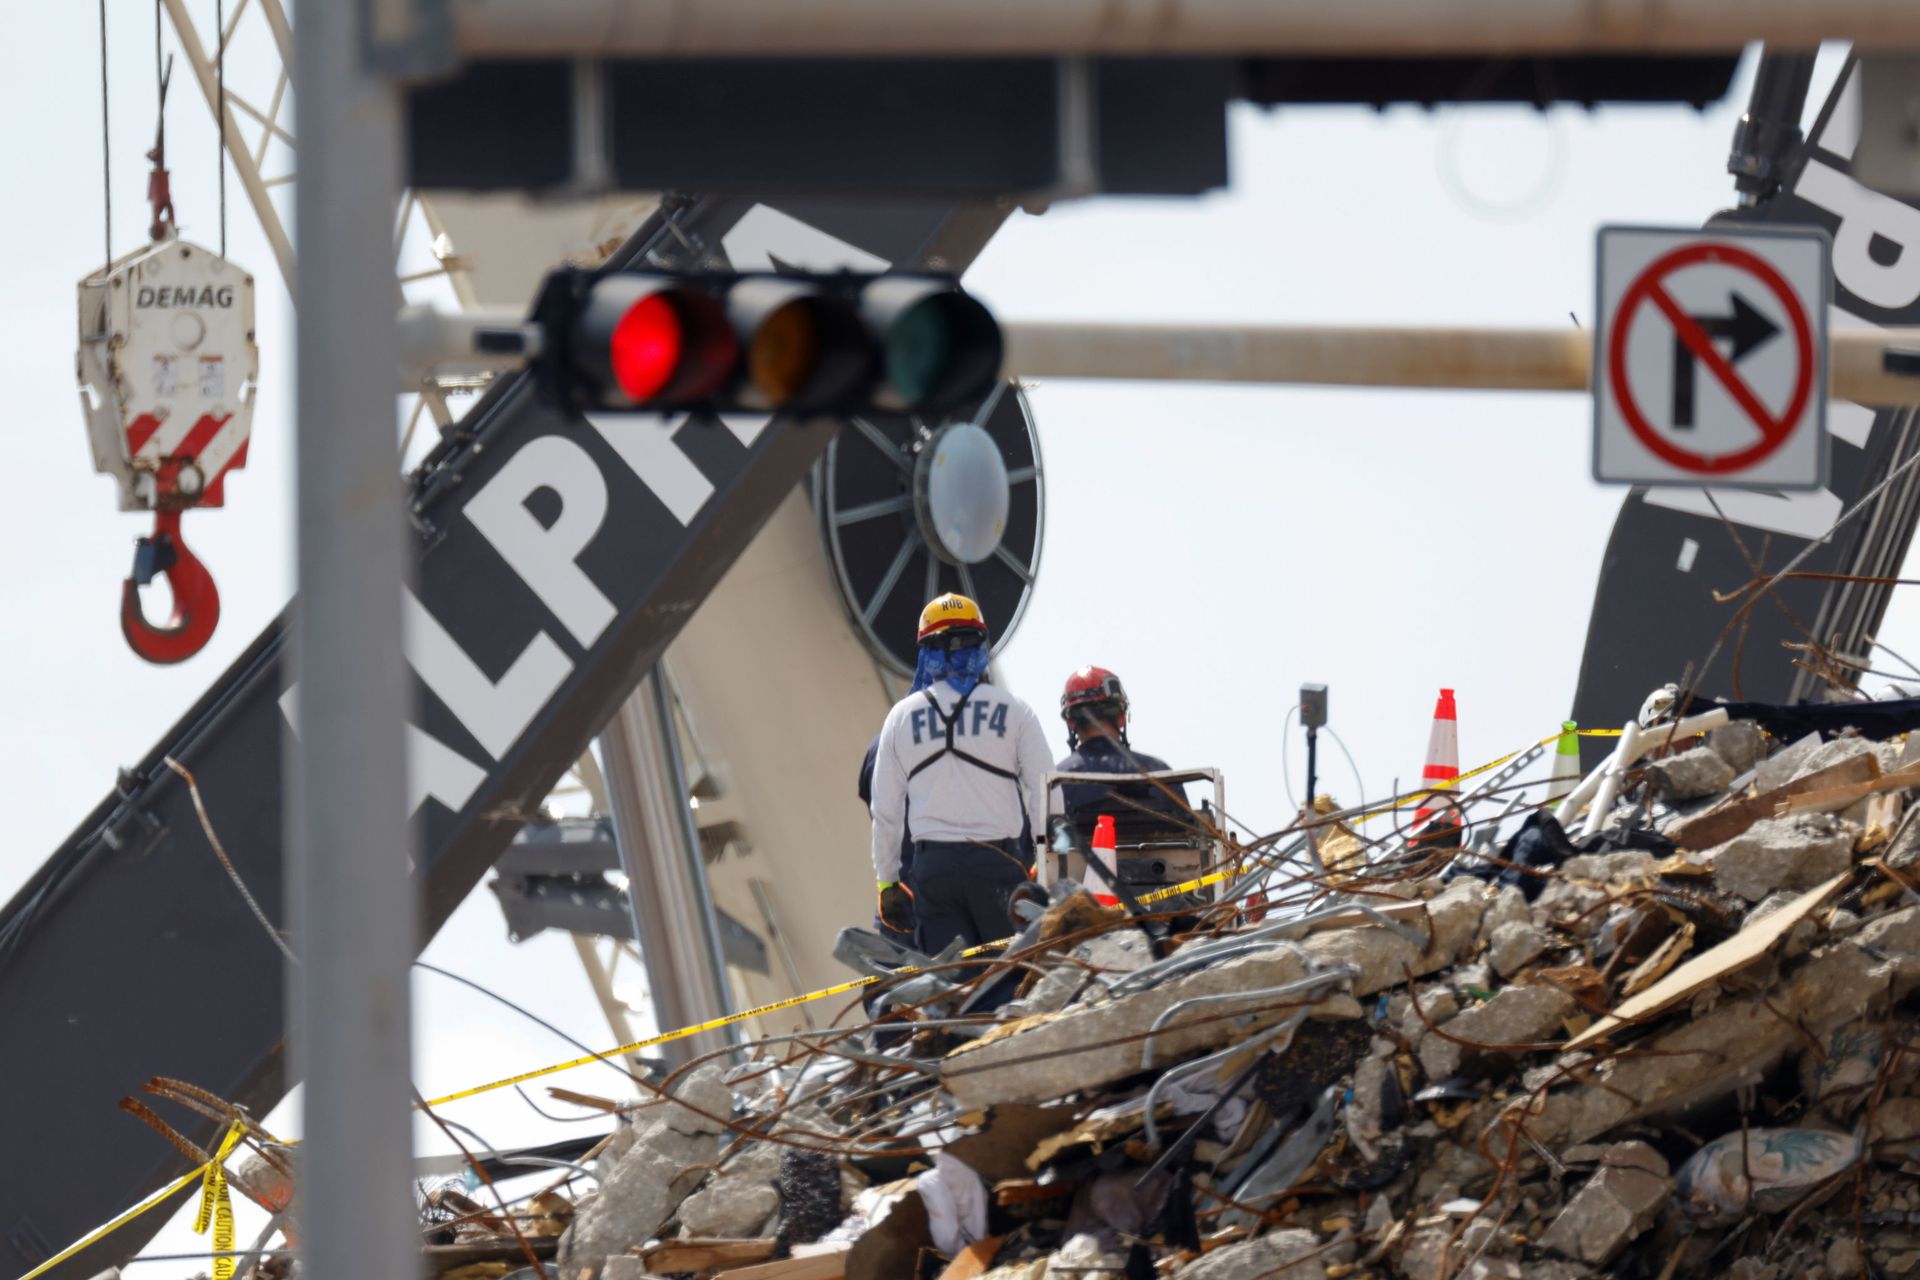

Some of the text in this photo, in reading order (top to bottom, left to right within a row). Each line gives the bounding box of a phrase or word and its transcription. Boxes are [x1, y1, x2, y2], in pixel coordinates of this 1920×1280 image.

[136, 285, 234, 309] DEMAG
[942, 599, 963, 611] ROB
[215, 1207, 232, 1252] CAUTION
[215, 1256, 232, 1280] CAU
